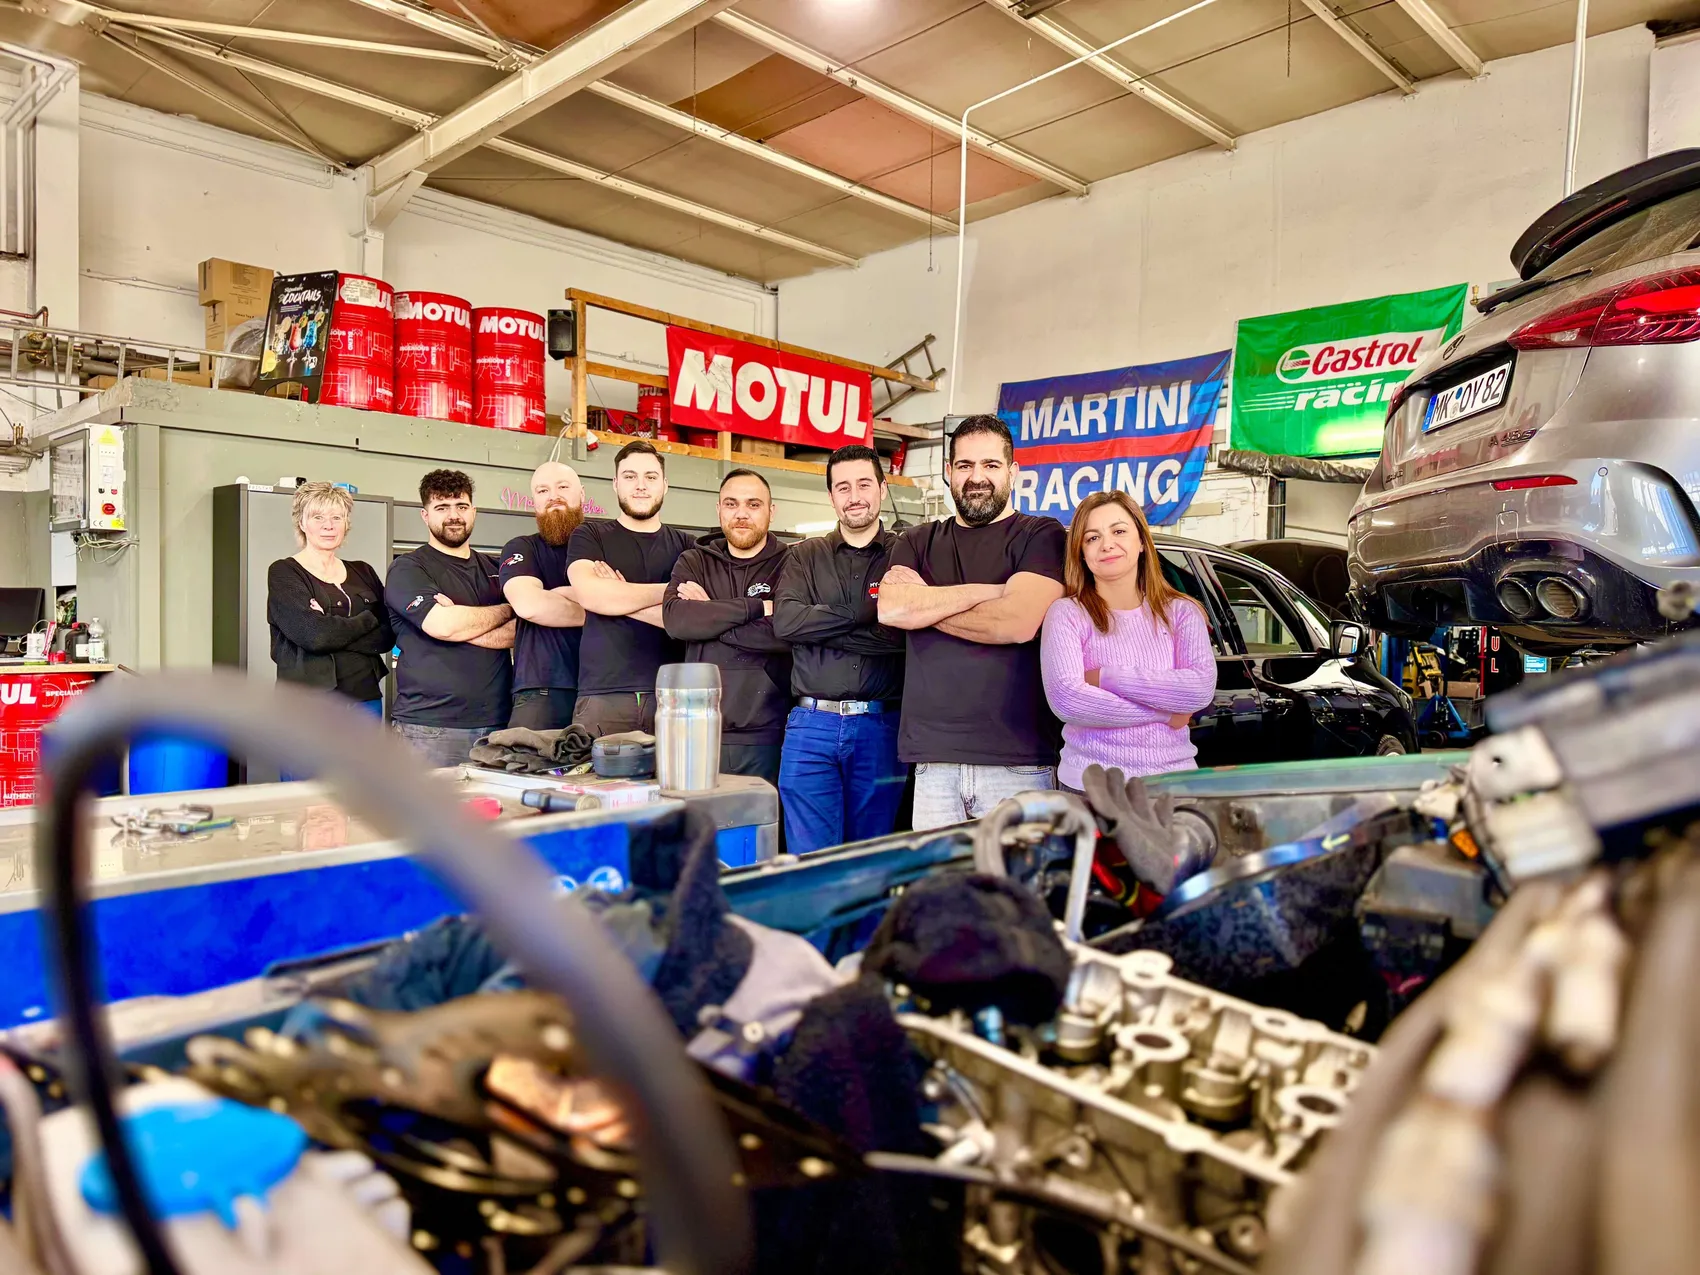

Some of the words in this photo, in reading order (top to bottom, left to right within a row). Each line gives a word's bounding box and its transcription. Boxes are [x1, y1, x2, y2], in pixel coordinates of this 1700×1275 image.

[282, 289, 321, 305] COCKTAILS
[479, 316, 545, 342] MOTUL
[1312, 336, 1423, 375] Castrol
[638, 386, 663, 397] OTUL
[673, 348, 867, 439] MOTUL
[1020, 380, 1192, 441] MARTINI
[1431, 391, 1455, 424] MK
[1460, 378, 1484, 413] OY
[1482, 368, 1506, 404] 82
[1014, 459, 1182, 511] RACING
[0, 683, 37, 705] UL
